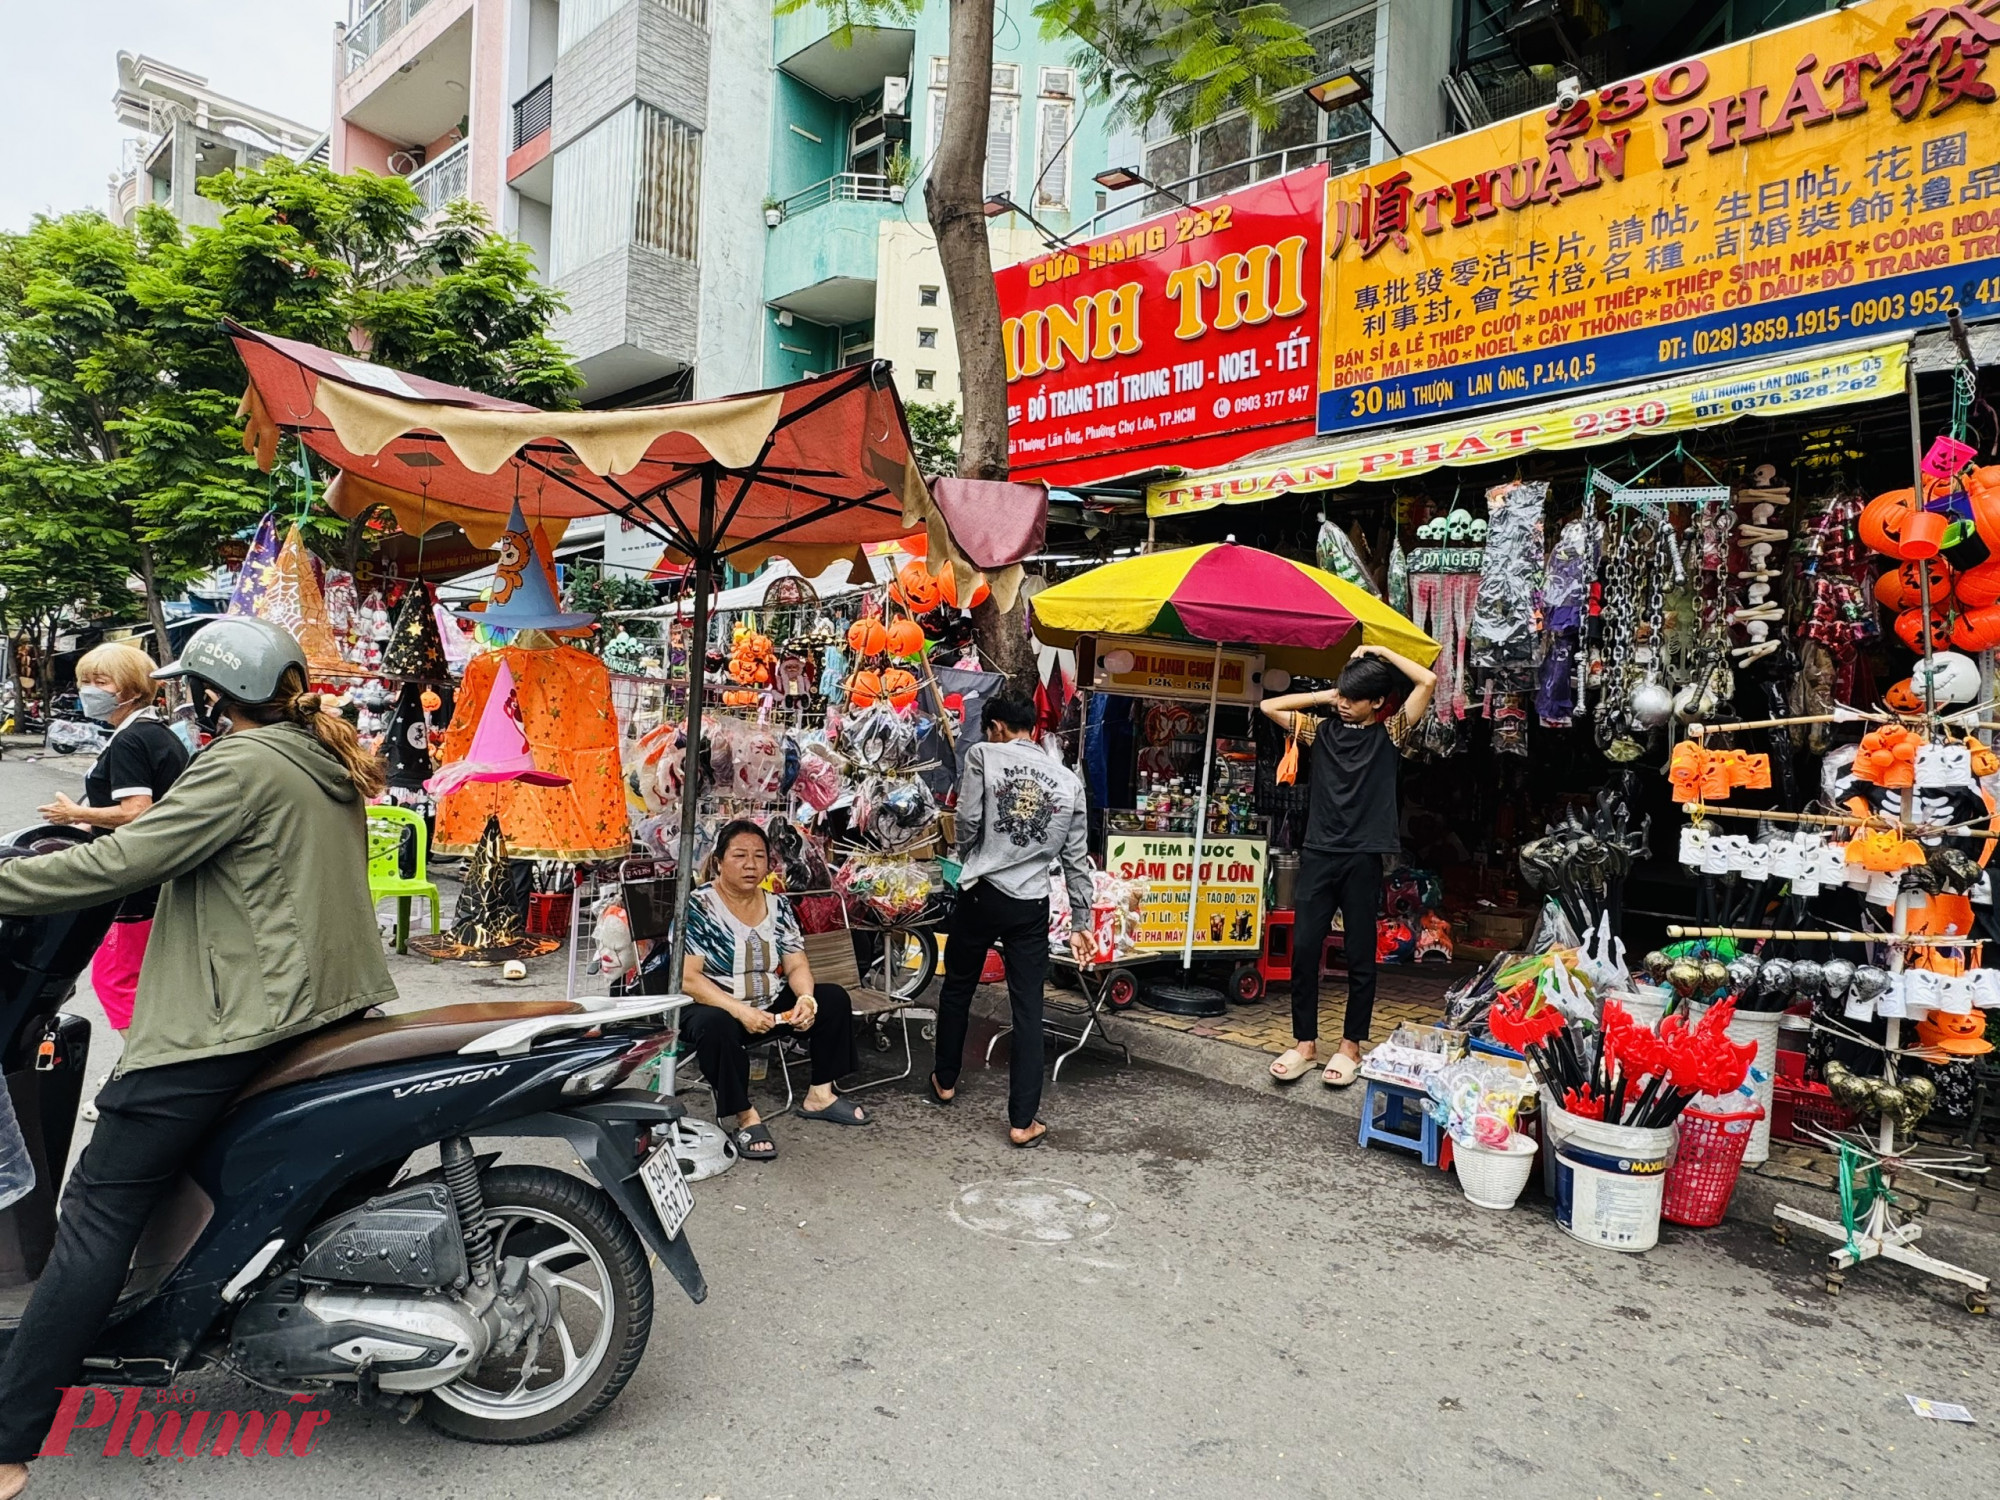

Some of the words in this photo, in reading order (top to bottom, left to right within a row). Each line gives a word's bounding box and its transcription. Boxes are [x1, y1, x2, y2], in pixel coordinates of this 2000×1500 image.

[1870, 0, 2000, 123] 發
[1545, 60, 1710, 145] 230
[1414, 128, 1631, 237] THUẬN
[1662, 52, 1883, 170] PHÁT
[1330, 170, 1413, 261] 順
[1029, 252, 1080, 288] CỬA
[1089, 226, 1167, 270] HÀNG
[1175, 204, 1233, 245] 232
[1166, 235, 1308, 341] THI
[1334, 348, 1364, 370] BÁN
[1538, 300, 1586, 325] DANH
[1663, 268, 1724, 298] THIỆP
[1728, 256, 1781, 284] SINH
[1790, 240, 1852, 272] NHẬT
[1334, 364, 1373, 388] BÔNG
[1381, 358, 1410, 379] MAI
[1427, 348, 1459, 369] ĐÀO
[1475, 335, 1518, 359] NOEL
[1538, 323, 1572, 346] CÂY
[1579, 309, 1643, 338] THÔNG
[1660, 294, 1715, 322] BÔNG
[1760, 273, 1804, 300] DÂU
[1864, 244, 1950, 279] TRANG
[1658, 335, 1687, 363] ĐT:
[1028, 384, 1047, 423] ĐỒ
[1050, 388, 1093, 418] TRANG
[1095, 372, 1120, 409] TRÍ
[1122, 368, 1170, 403] TRUNG
[1173, 360, 1205, 394] THU
[1218, 348, 1261, 385] NOEL
[1276, 326, 1311, 372] TẾT
[1387, 383, 1406, 411] HẢI
[1498, 365, 1529, 391] ÔNG,
[1731, 374, 1877, 412] 0376.328.262
[1118, 421, 1135, 436] Chợ
[1159, 407, 1196, 427] TP.HCM
[1234, 394, 1261, 413] 0903
[1264, 390, 1285, 408] 377
[1288, 385, 1310, 402] 847
[1158, 461, 1340, 507] THUẬN
[1358, 424, 1545, 475] PHÁT
[1573, 400, 1669, 441] 230
[1422, 552, 1481, 567] DANGER
[1148, 678, 1172, 688] 12K
[1120, 858, 1166, 881] SÂM
[1143, 841, 1182, 860] TIỆM
[1145, 930, 1162, 942] PHA
[393, 1064, 511, 1099] VISION
